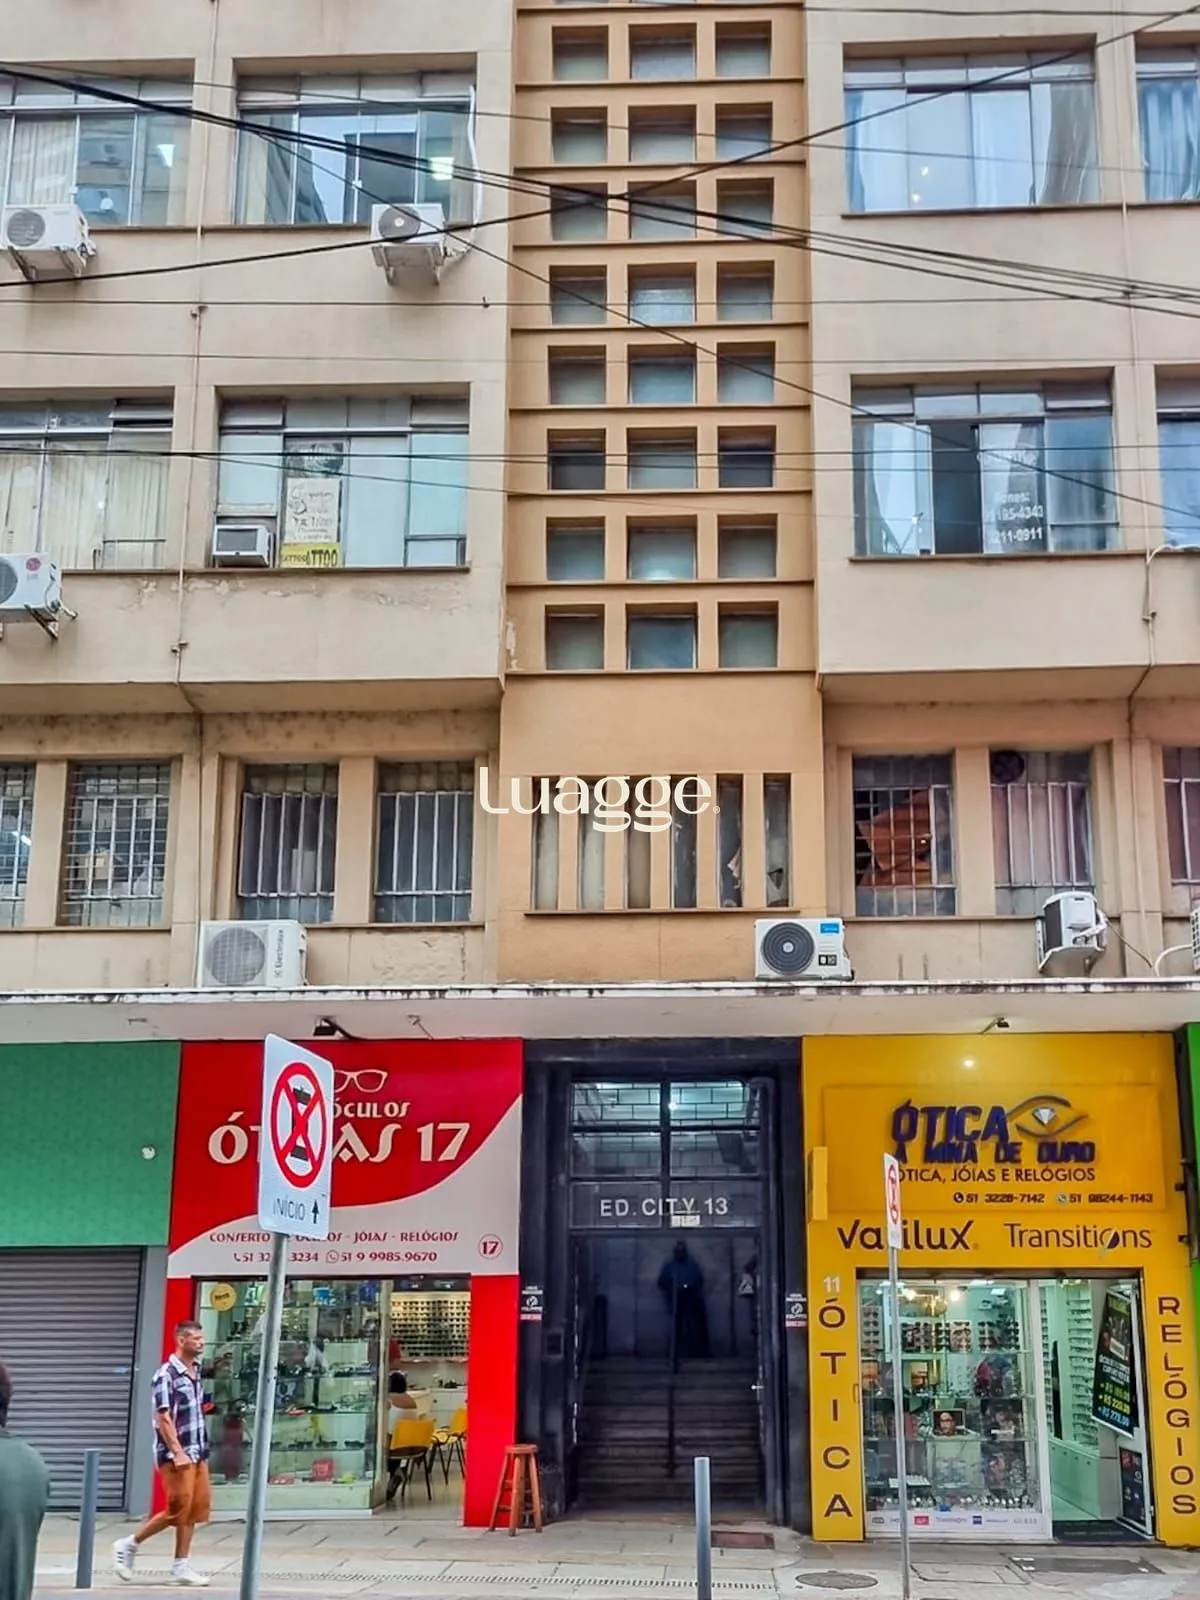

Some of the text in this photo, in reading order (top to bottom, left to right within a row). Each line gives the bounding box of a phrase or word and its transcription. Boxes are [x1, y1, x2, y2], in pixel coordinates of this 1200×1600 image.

[892, 1098, 1009, 1141] ÓTICA
[417, 1122, 470, 1163] 17
[924, 1141, 978, 1163] MINA
[995, 1141, 1023, 1163] DE
[952, 1165, 995, 1182] JÓIAS
[1002, 1168, 1012, 1181] E
[1016, 1164, 1095, 1182] RELÓGIOS
[641, 1198, 696, 1216] CITY
[704, 1197, 729, 1215] 13
[966, 1193, 979, 1203] 51
[1070, 1193, 1082, 1203] 51
[209, 1231, 271, 1243] CONSERTO
[353, 1230, 388, 1243] JÓIAS
[400, 1230, 459, 1243] RELÓGIOS
[837, 1219, 974, 1250] Vailux
[1004, 1222, 1152, 1250] Transitions
[341, 1252, 352, 1262] 51
[357, 1252, 365, 1262] 9
[482, 1240, 500, 1255] 17
[819, 1297, 853, 1517] ÓTICA
[1158, 1296, 1197, 1514] RELÓGIOS
